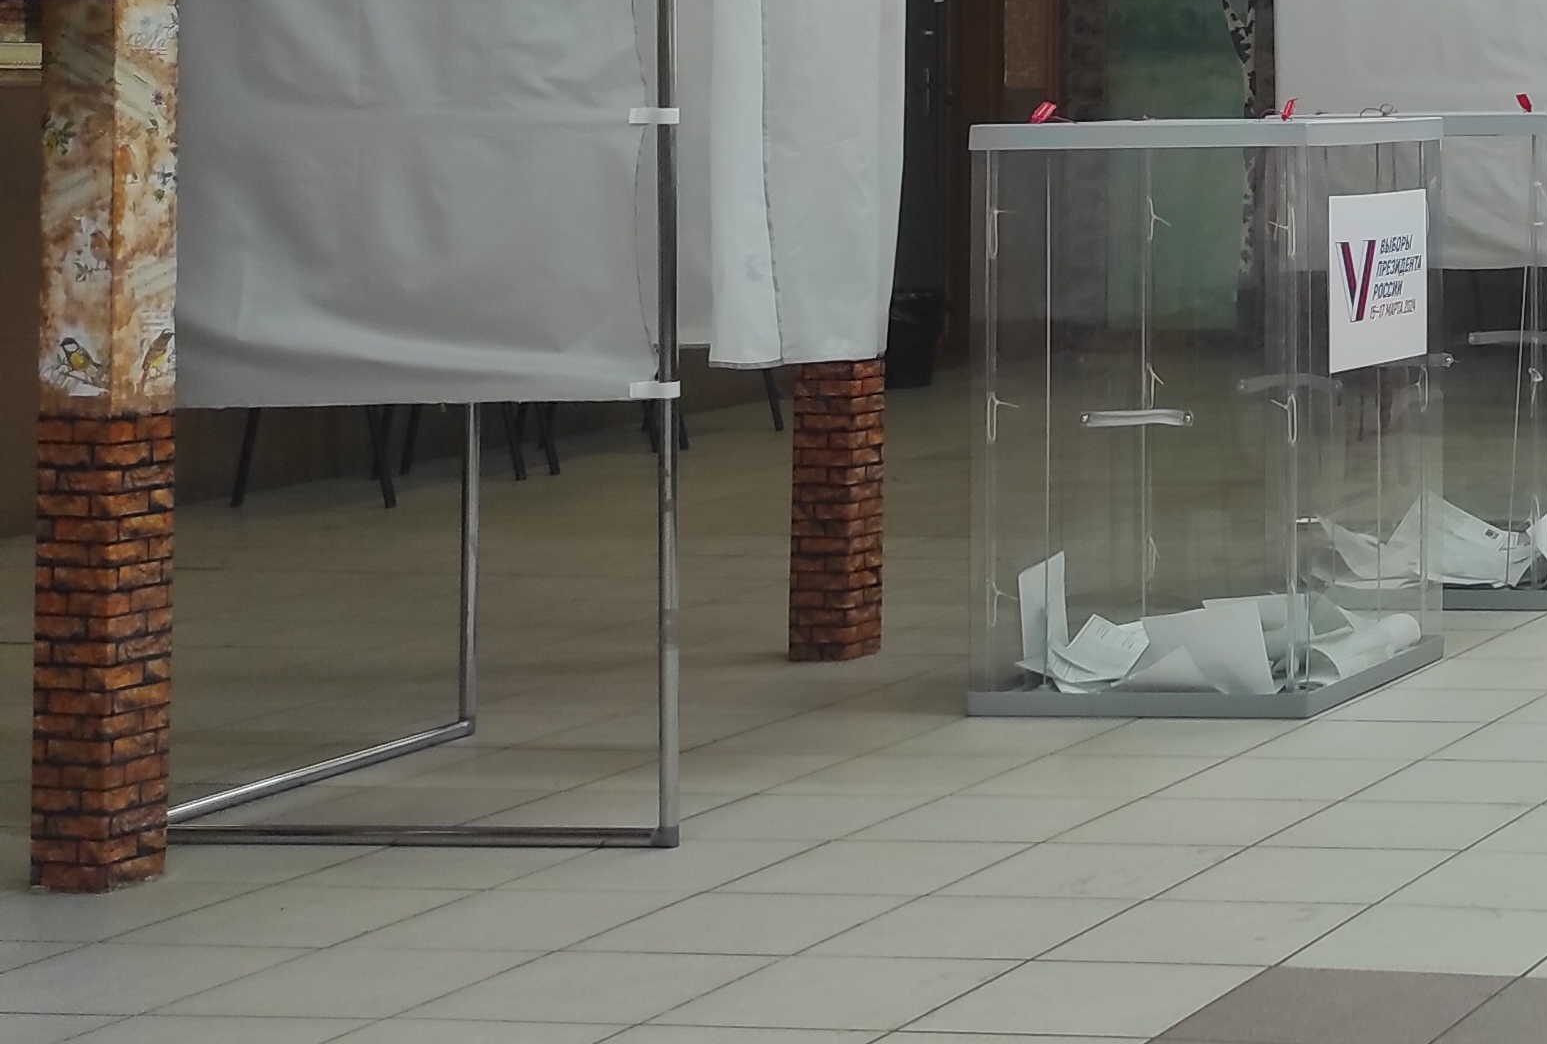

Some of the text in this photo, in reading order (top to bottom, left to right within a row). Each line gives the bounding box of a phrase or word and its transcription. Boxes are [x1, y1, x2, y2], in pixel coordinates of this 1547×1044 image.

[1379, 234, 1413, 254] ВЫБОРЫ
[1375, 255, 1422, 277] ПРЕЗИДЕНТА
[1372, 281, 1403, 301] РОССИИ
